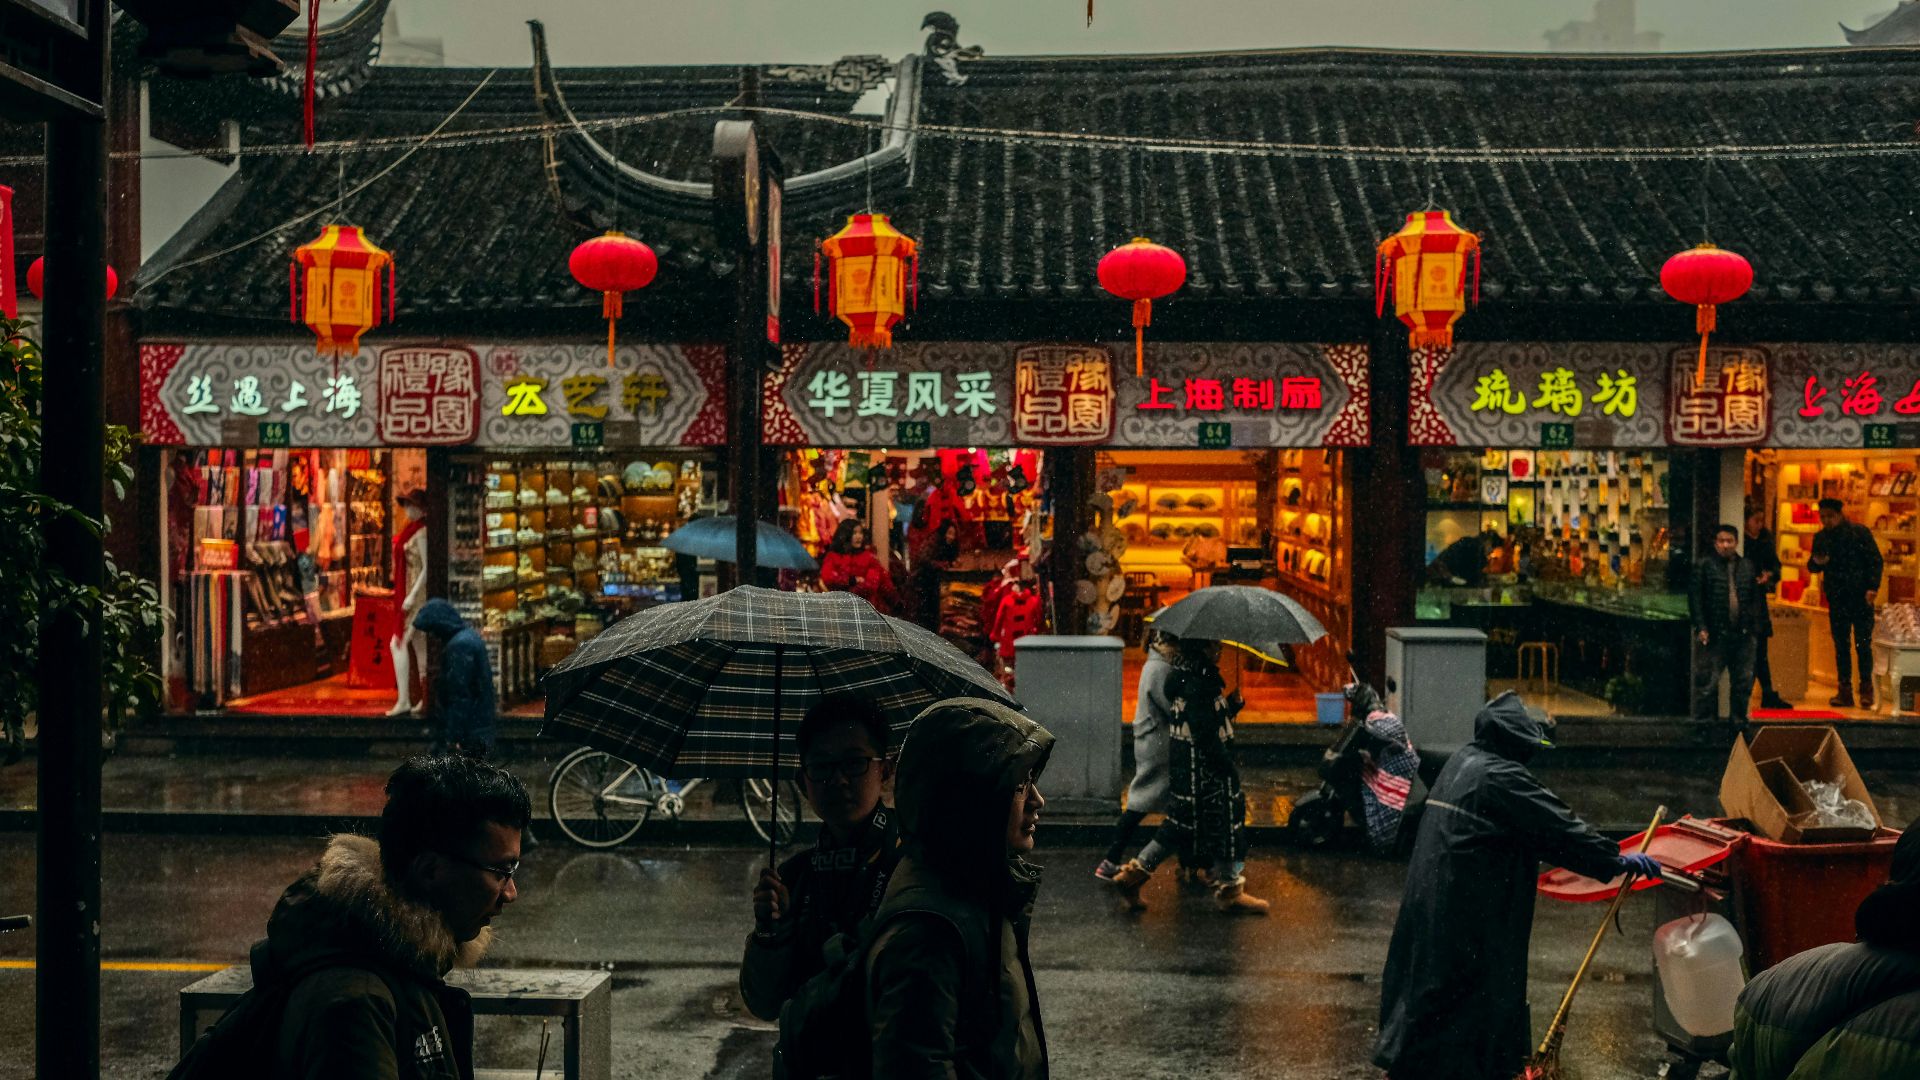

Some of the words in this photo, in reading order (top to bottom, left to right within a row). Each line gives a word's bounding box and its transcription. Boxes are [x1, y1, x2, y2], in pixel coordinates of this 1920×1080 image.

[182, 374, 362, 419] 丝遇上海
[808, 370, 998, 418] 华夏风采
[1137, 376, 1323, 411] 上海制扇
[1471, 367, 1638, 417] 琉璃坊
[266, 424, 282, 438] 66
[579, 424, 596, 438] 66
[905, 424, 922, 437] 64
[1206, 425, 1222, 438] 64
[1548, 425, 1566, 439] 62
[1871, 426, 1889, 440] 62
